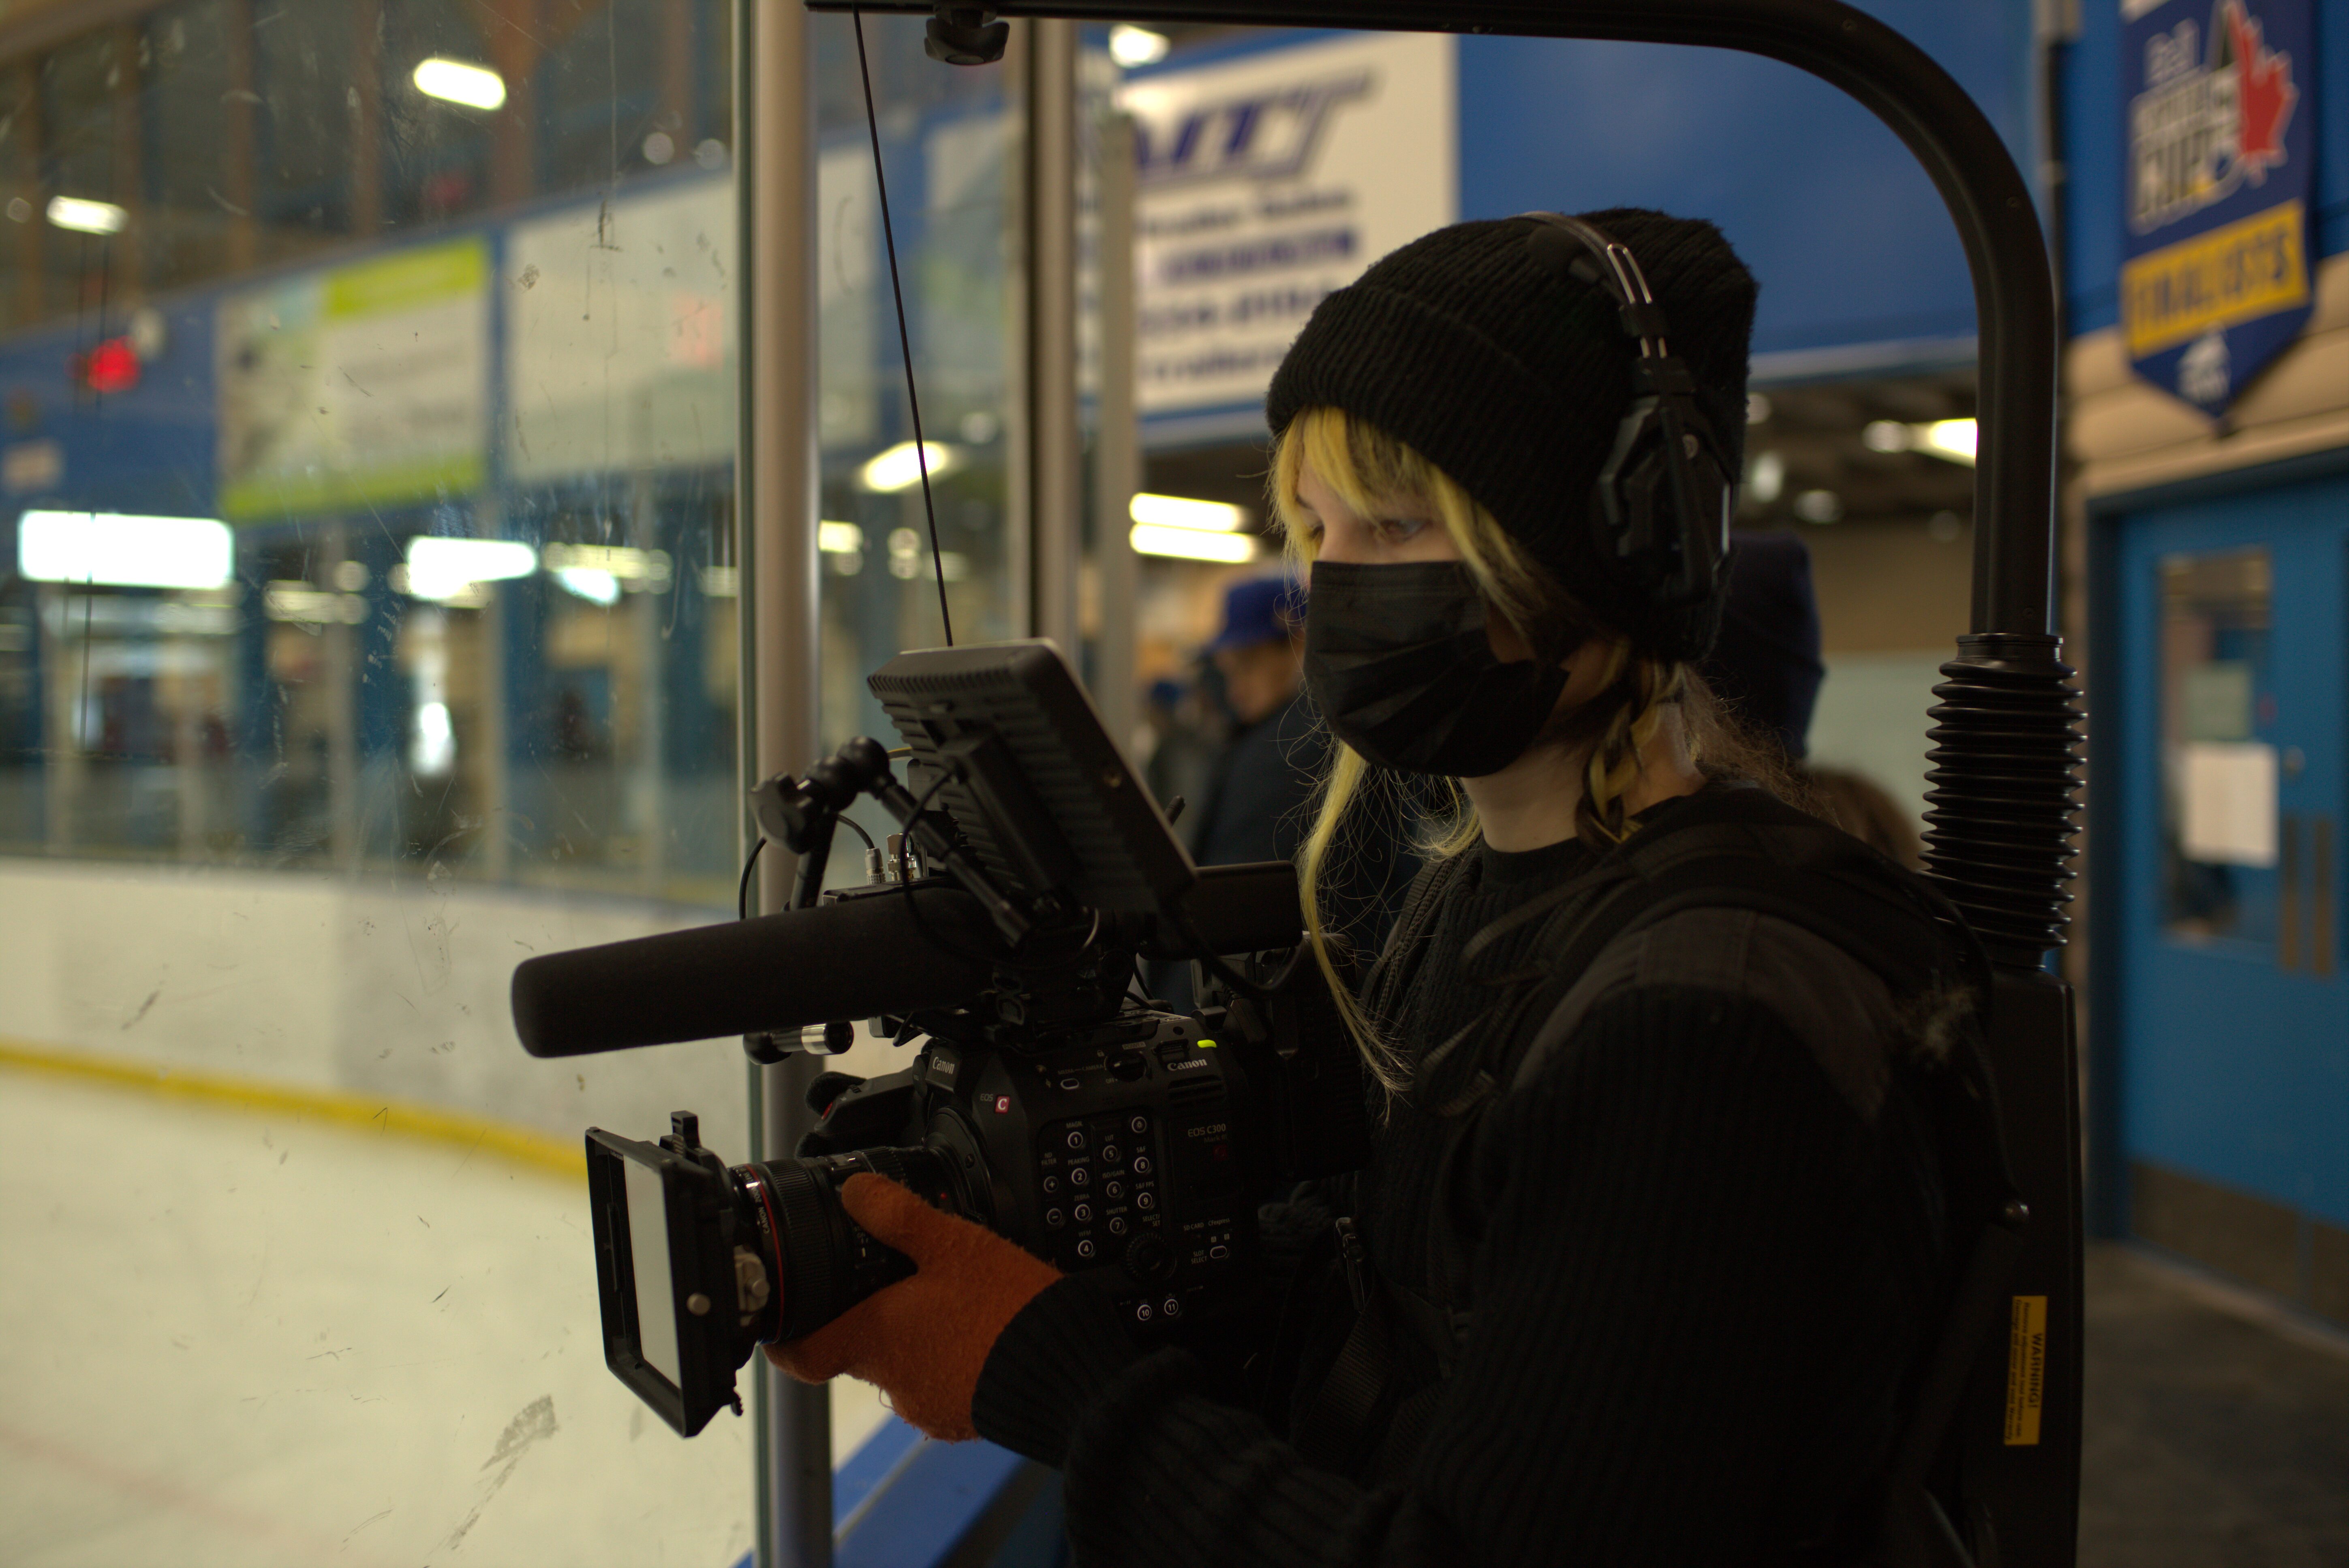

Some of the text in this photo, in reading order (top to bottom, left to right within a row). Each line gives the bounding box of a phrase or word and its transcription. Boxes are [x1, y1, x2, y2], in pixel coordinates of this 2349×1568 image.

[933, 1057, 955, 1074] Canon
[1167, 1059, 1207, 1071] Canon
[980, 1094, 993, 1102] EOS
[997, 1098, 1007, 1111] C
[1188, 1123, 1226, 1137] EOS C300
[1109, 1150, 1114, 1158] 5
[1068, 1156, 1090, 1166] PEAKING
[1140, 1161, 1146, 1169] 8
[1077, 1172, 1083, 1181] 2
[1102, 1169, 1125, 1179] ISO/GAIN
[1112, 1186, 1118, 1194] 6
[1074, 1193, 1090, 1202] ZEBRA
[1143, 1197, 1149, 1205] 9
[1080, 1209, 1086, 1217] 3
[1106, 1206, 1127, 1216] SHUTTER
[758, 1206, 770, 1234] CANON
[1191, 1222, 1204, 1230] CARD
[1208, 1218, 1230, 1226] CFexpress
[1115, 1222, 1120, 1230] 7
[1084, 1244, 1089, 1252] 4
[1191, 1256, 1207, 1265] SELECT
[1168, 1303, 1175, 1312] 11
[1142, 1308, 1149, 1317] 10
[2028, 1333, 2042, 1407] WARNING!
